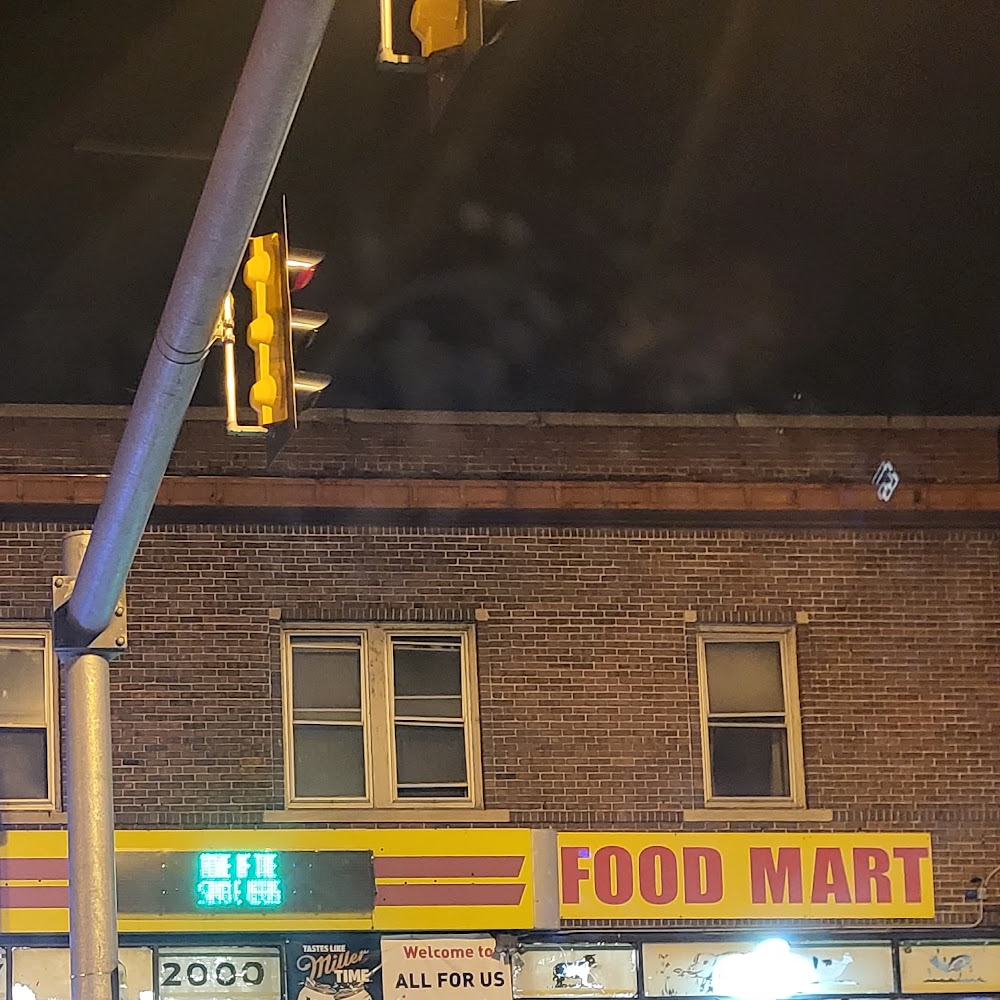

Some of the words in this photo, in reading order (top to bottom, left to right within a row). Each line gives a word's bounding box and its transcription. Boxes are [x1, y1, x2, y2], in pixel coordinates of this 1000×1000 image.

[561, 846, 723, 904] FOOD
[750, 847, 928, 904] MART
[303, 945, 329, 953] TASTES
[330, 945, 346, 953] LIKE
[403, 946, 474, 959] Welcome
[478, 946, 493, 958] to
[297, 950, 369, 980] Miller
[161, 961, 265, 987] 2000
[335, 969, 370, 983] TIME
[395, 973, 432, 989] ALL
[437, 973, 475, 988] FOR
[480, 972, 505, 987] US
